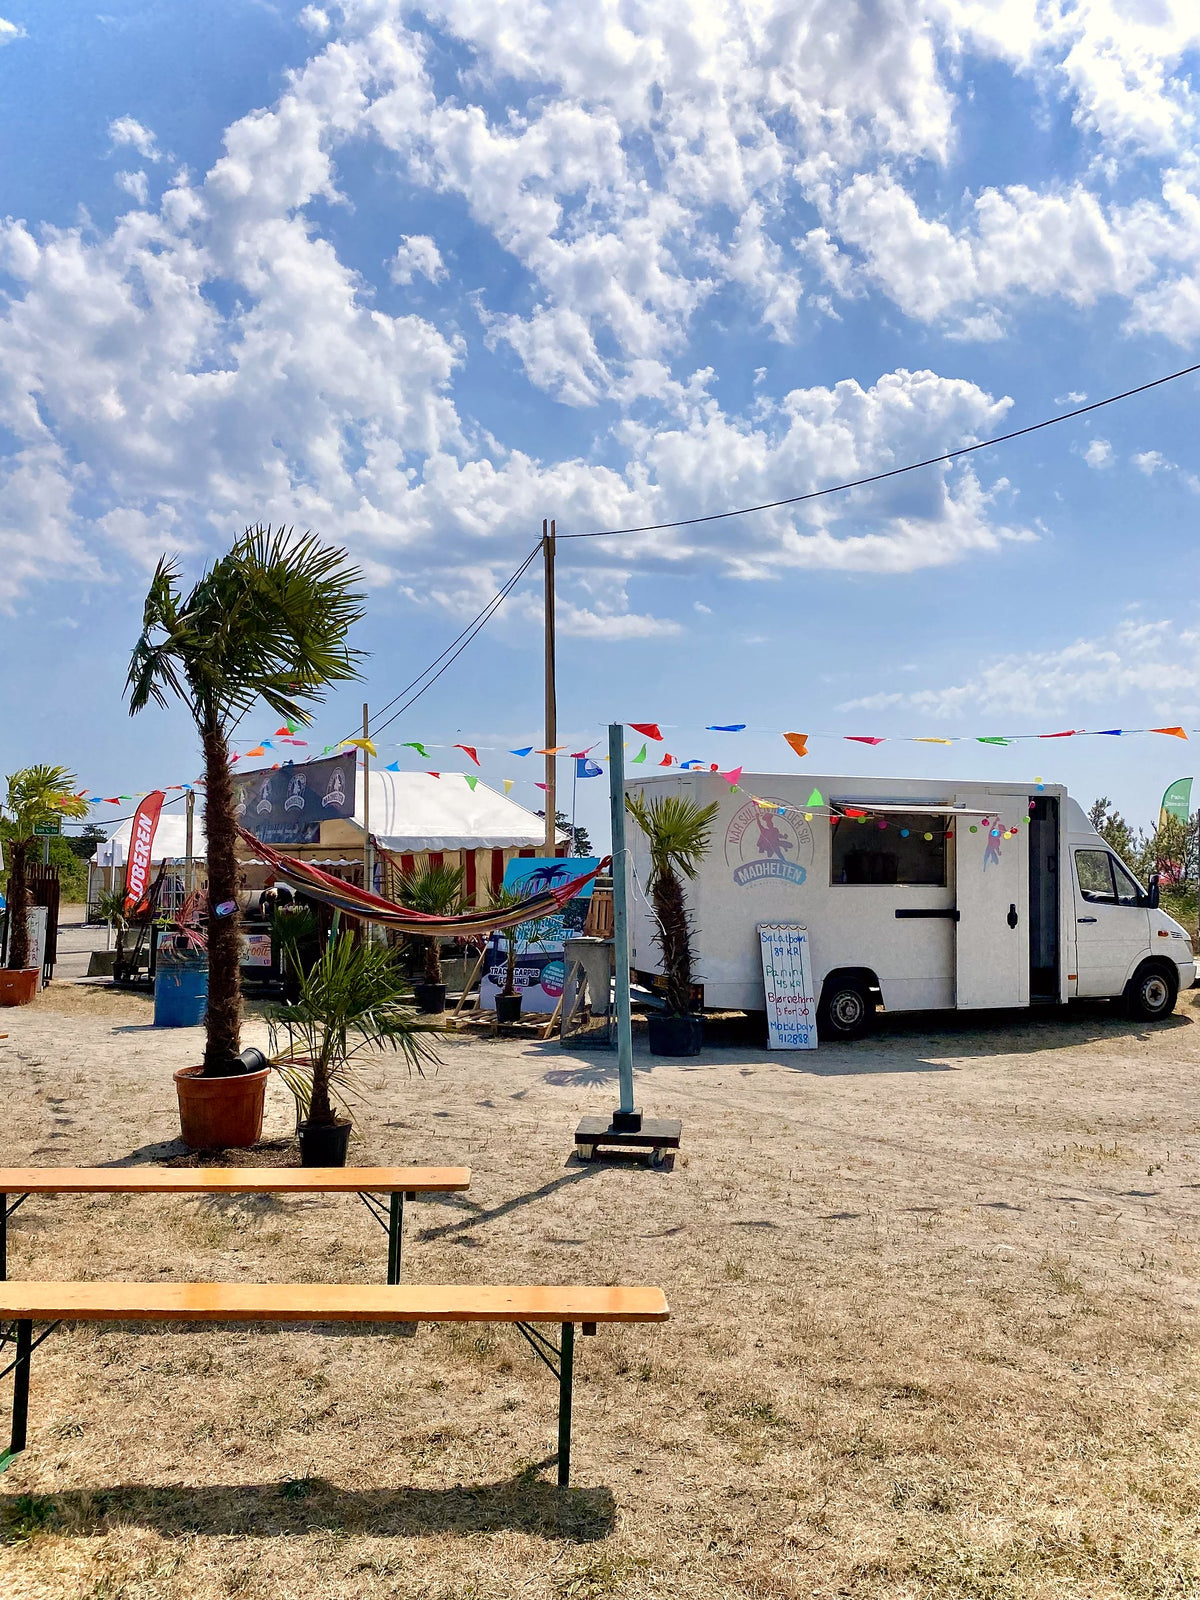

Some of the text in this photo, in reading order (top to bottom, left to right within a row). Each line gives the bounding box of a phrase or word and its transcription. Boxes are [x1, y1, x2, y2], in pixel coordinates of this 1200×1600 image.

[799, 828, 811, 844] SIG
[737, 862, 803, 884] MADHELTEN
[774, 947, 784, 957] 89
[490, 967, 540, 977] TRACCARPUS
[766, 964, 803, 977] Panini
[776, 979, 788, 989] 45
[798, 1007, 809, 1016] 30
